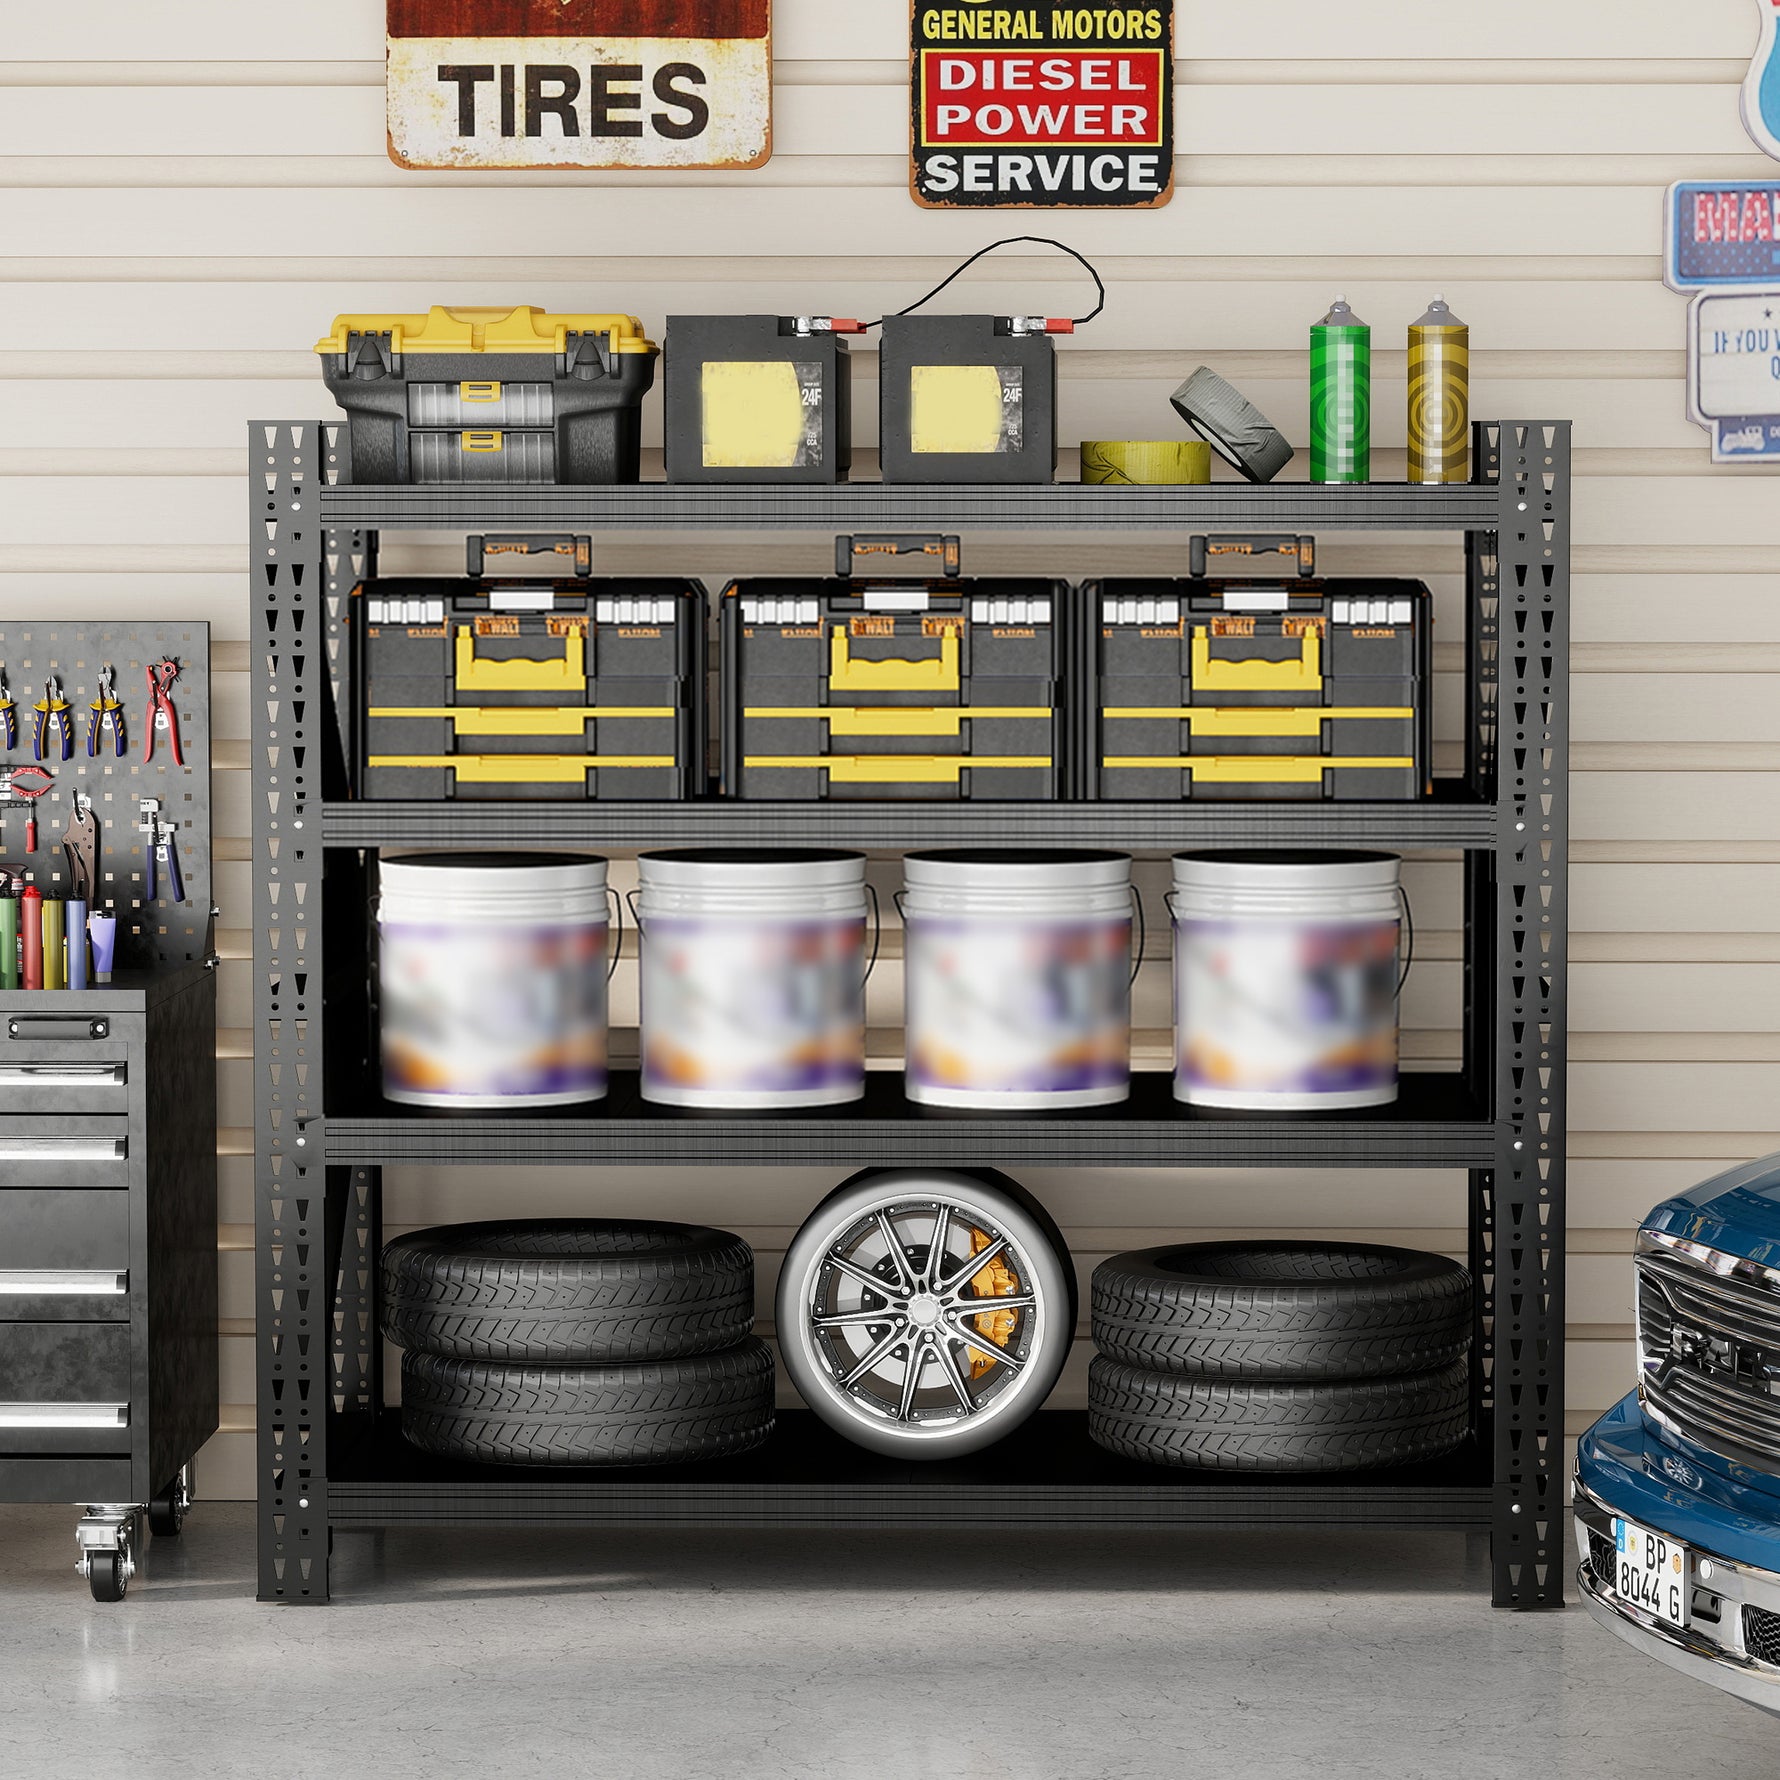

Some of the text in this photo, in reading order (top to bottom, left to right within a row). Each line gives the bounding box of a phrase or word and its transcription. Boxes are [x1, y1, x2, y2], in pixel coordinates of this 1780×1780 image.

[922, 9, 1162, 40] GENERAL MOTORS
[939, 59, 1146, 91] DIESEL
[437, 62, 709, 140] TIRES
[936, 104, 1148, 136] POWER
[924, 154, 1159, 192] SERVICE
[1736, 329, 1769, 353] YOU
[801, 388, 822, 406] 24F
[1003, 388, 1022, 403] 24F
[1646, 1533, 1666, 1574] BP
[1621, 1561, 1679, 1622] 8044 G
